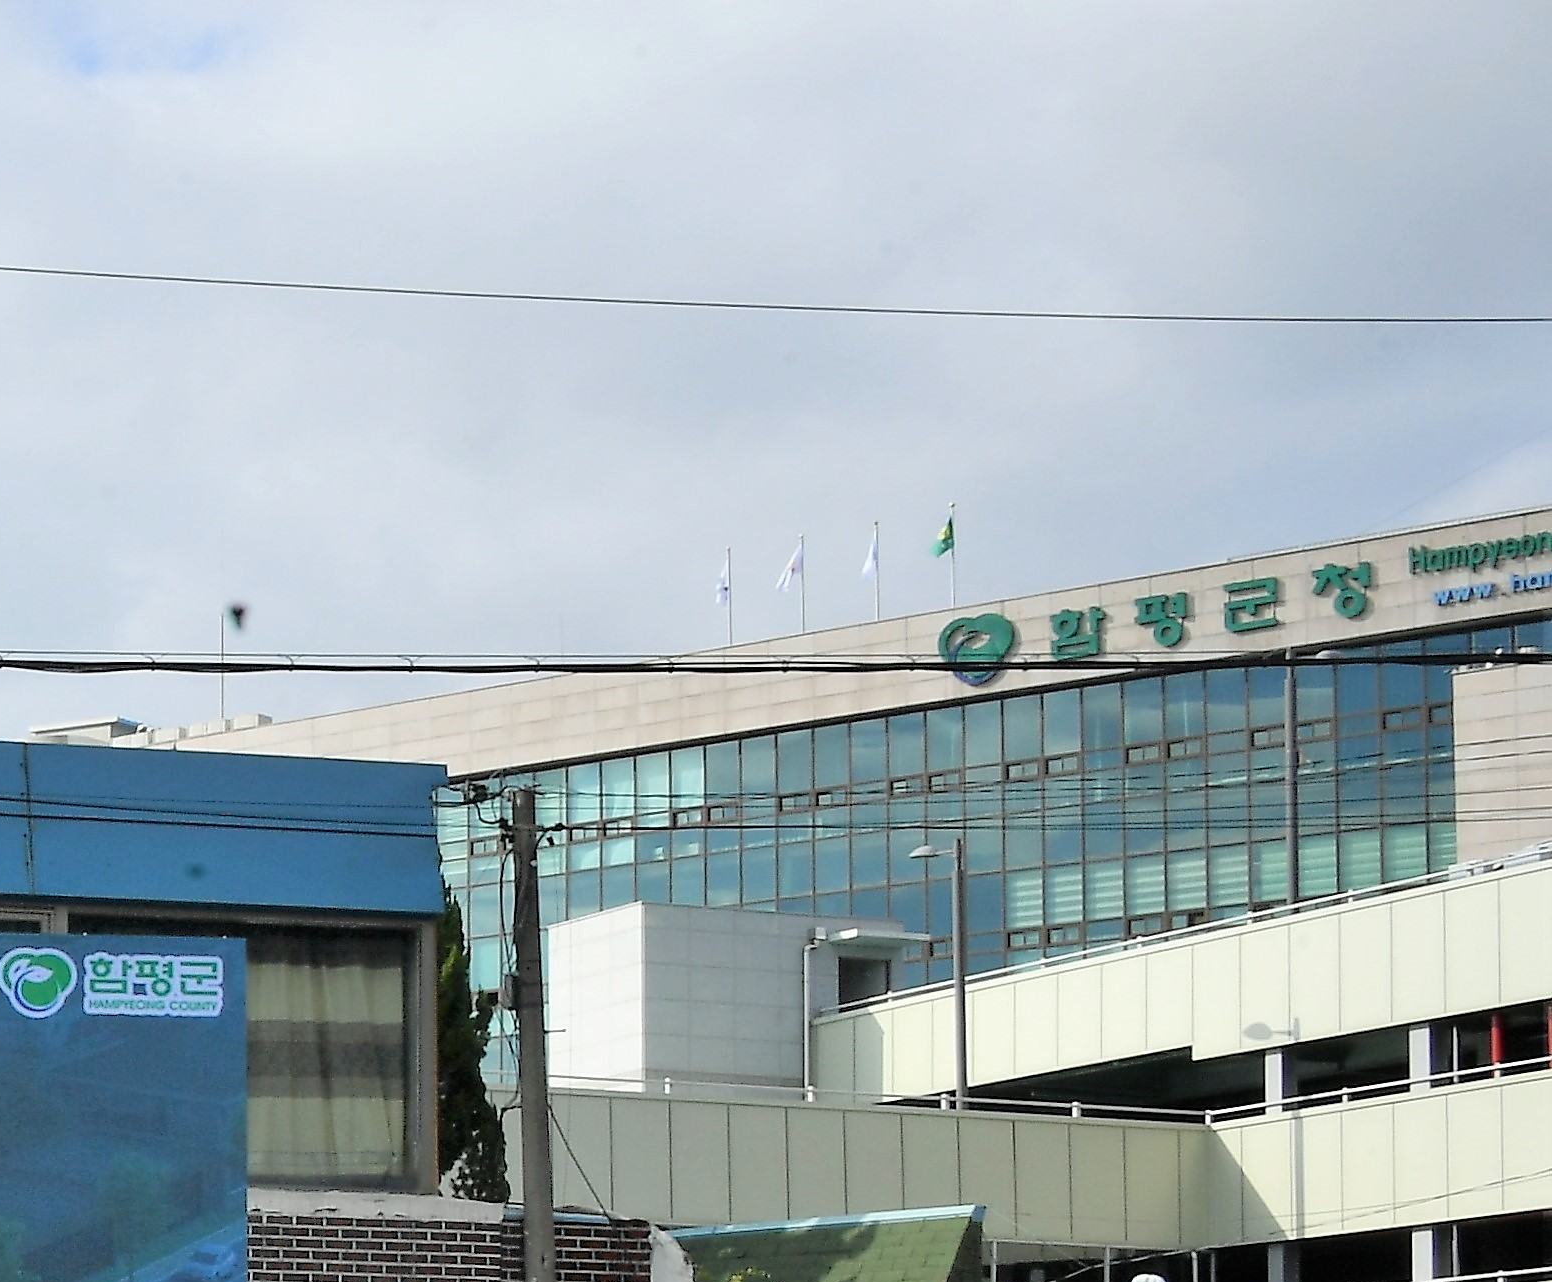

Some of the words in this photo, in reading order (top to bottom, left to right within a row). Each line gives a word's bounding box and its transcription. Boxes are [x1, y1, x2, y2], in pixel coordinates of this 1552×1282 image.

[1050, 561, 1371, 660] 함평군청
[89, 959, 218, 996] 함평군
[89, 1000, 165, 1011] HAMPYEONG
[169, 1001, 217, 1012] COUNTY
